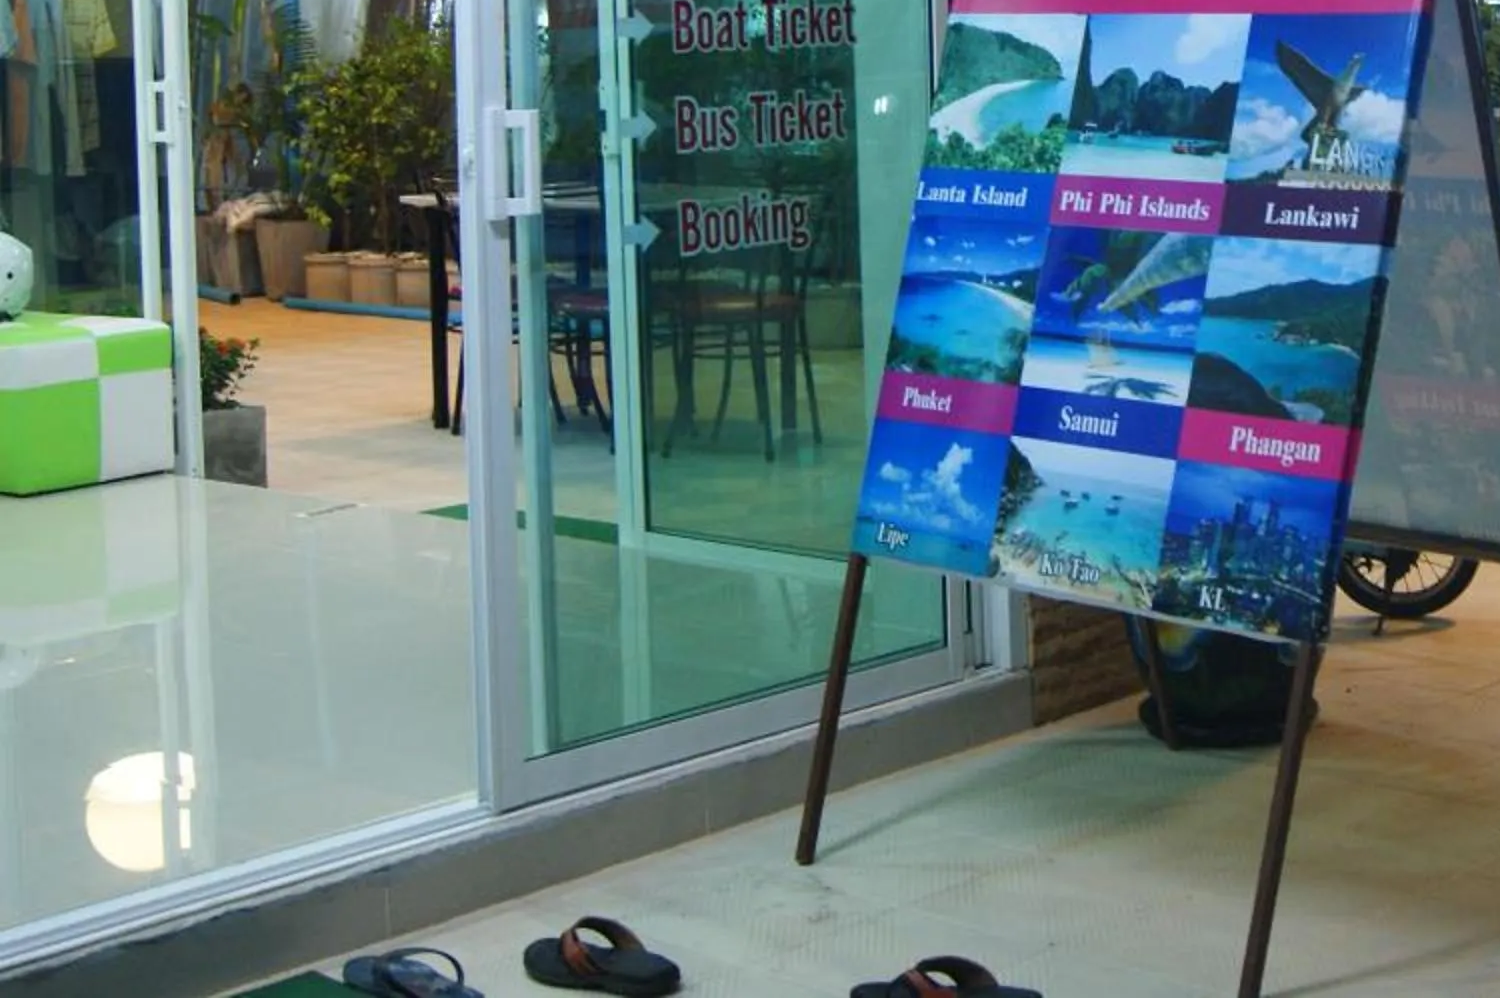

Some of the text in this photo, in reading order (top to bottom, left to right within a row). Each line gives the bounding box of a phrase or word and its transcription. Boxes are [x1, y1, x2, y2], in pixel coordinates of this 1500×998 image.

[672, 0, 750, 53] Boat
[674, 91, 846, 153] Bus Ticket
[917, 182, 1028, 207] Lanta Island
[1060, 190, 1210, 220] Phi Phi Islands
[679, 199, 811, 254] Booking
[1264, 202, 1359, 230] Lankawi
[903, 386, 952, 413] Phuket
[1059, 406, 1119, 437] Samui
[1229, 426, 1321, 467] Phangan
[876, 522, 909, 550] Lipe
[1039, 554, 1099, 583] Ko Tao
